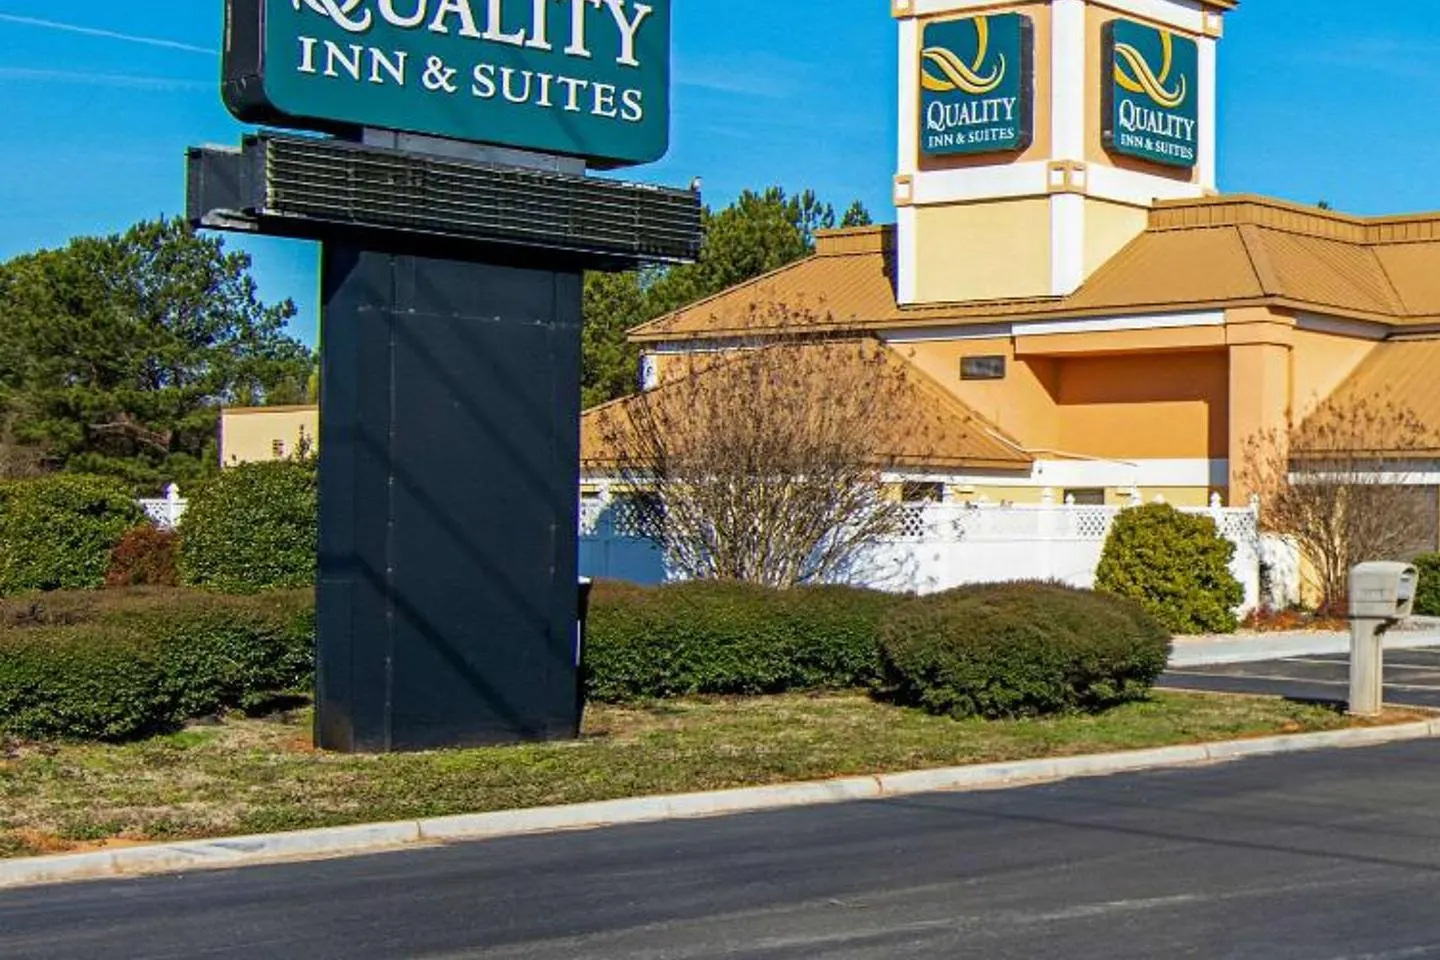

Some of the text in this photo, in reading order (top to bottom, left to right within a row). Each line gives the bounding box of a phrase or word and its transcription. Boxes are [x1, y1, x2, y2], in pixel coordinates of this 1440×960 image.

[296, 36, 644, 122] INN & SUITES
[926, 97, 1017, 131] QUALITY
[1119, 99, 1195, 141] QUALITY
[928, 128, 1015, 148] INN & SUITES
[1120, 133, 1143, 148] INN
[1154, 140, 1194, 160] SUITES
